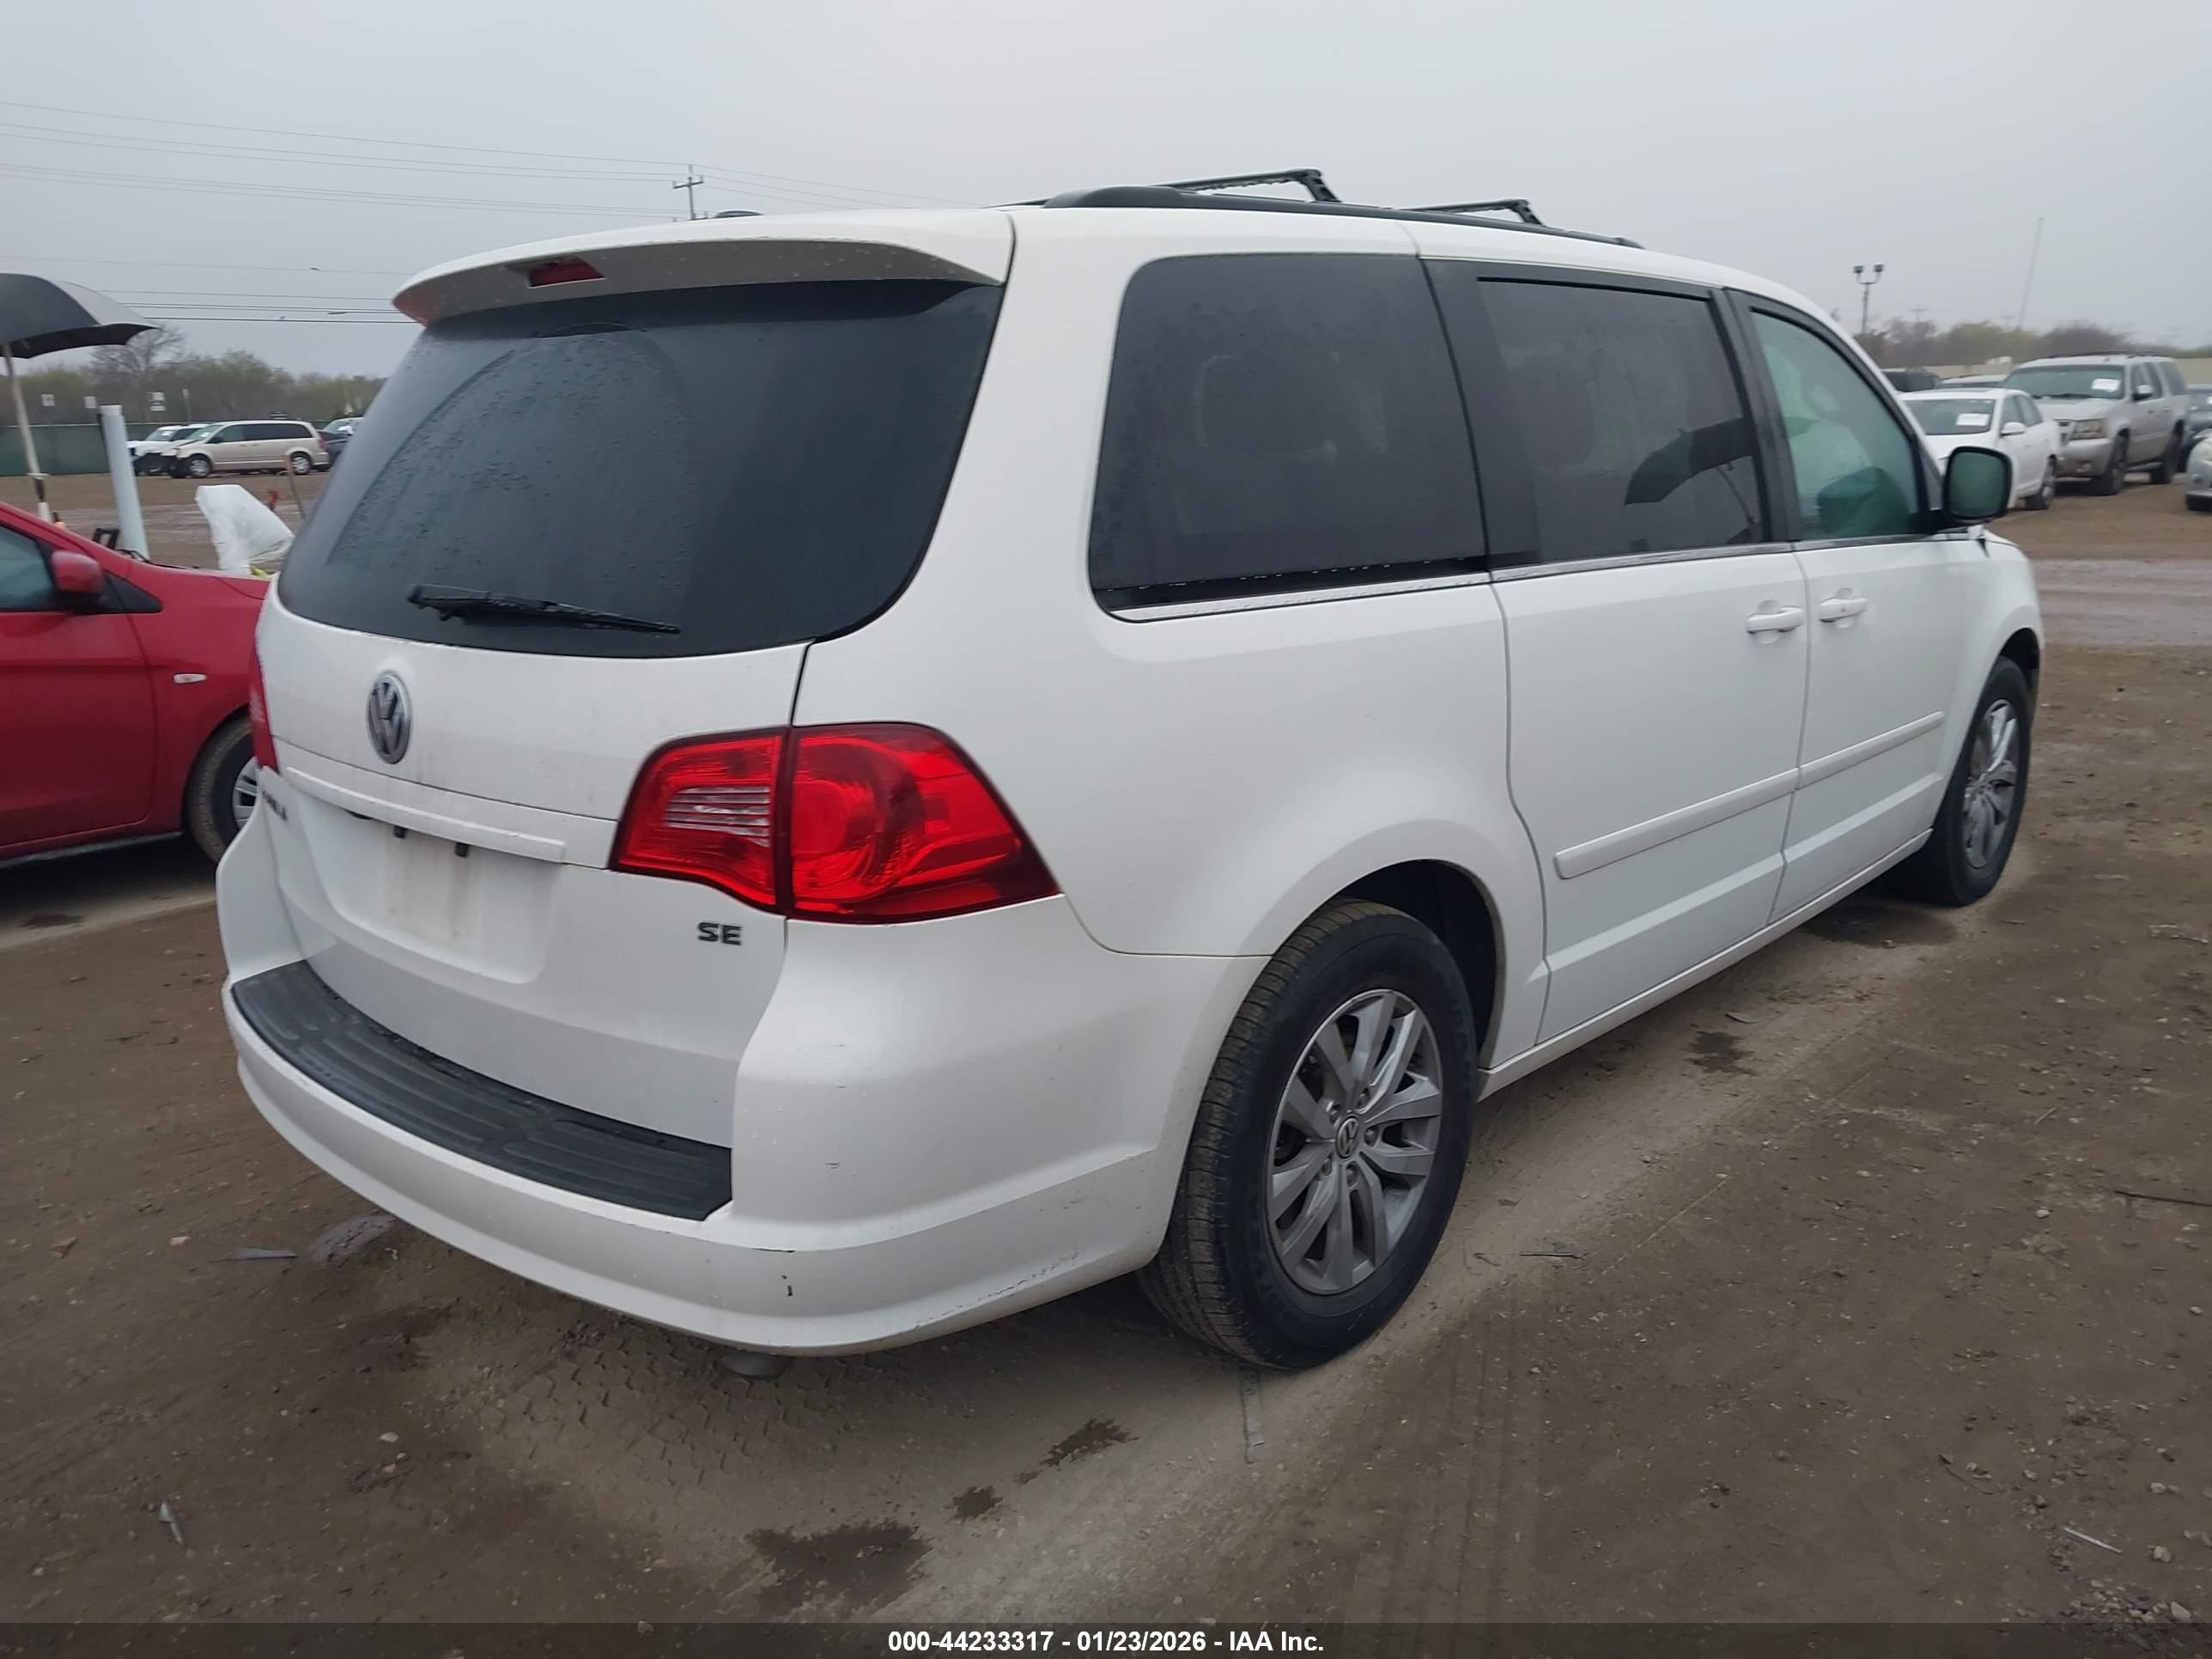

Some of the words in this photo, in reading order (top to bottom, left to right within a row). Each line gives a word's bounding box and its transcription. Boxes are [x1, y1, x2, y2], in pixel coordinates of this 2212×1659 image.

[368, 673, 410, 763] VW
[697, 921, 742, 946] SE
[1337, 1117, 1358, 1158] VW
